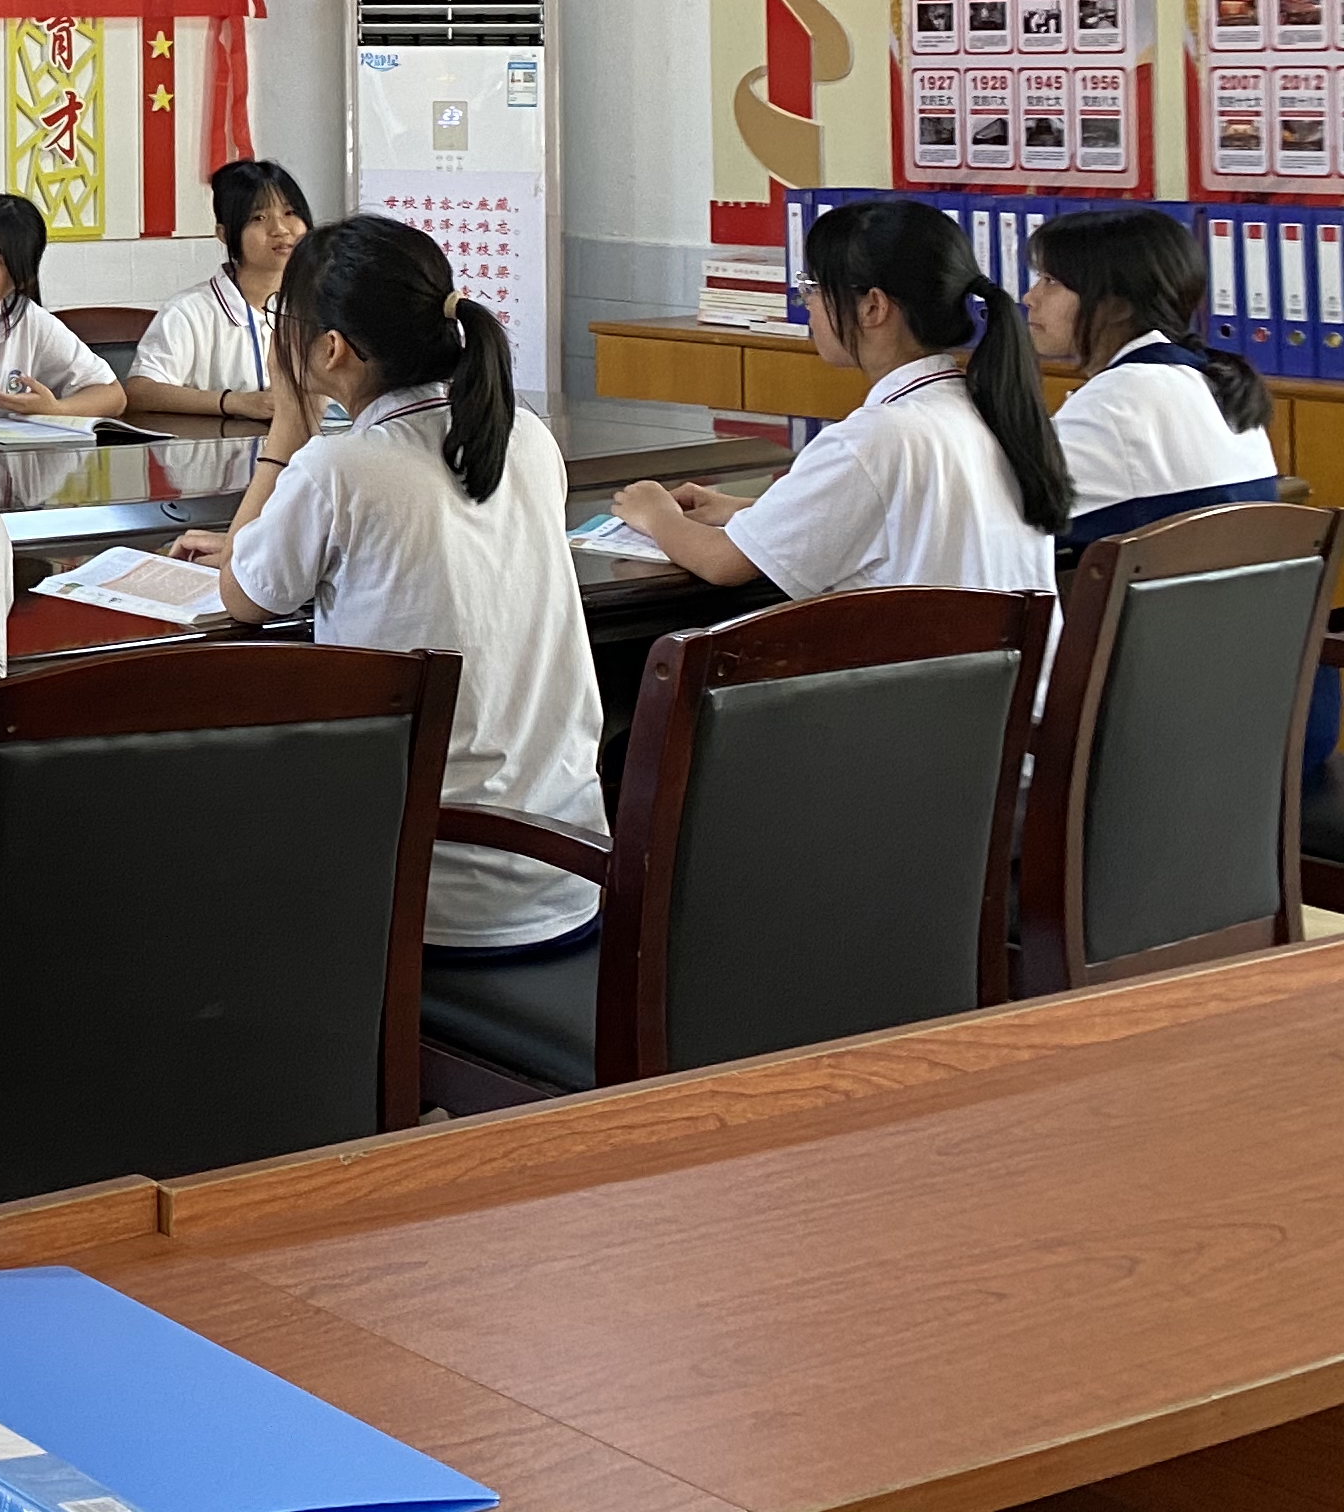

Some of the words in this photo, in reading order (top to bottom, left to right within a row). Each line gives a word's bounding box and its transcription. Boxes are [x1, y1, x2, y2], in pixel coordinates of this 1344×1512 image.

[919, 75, 955, 90] 1927
[971, 75, 1009, 90] 1928
[1026, 75, 1063, 90] 1945
